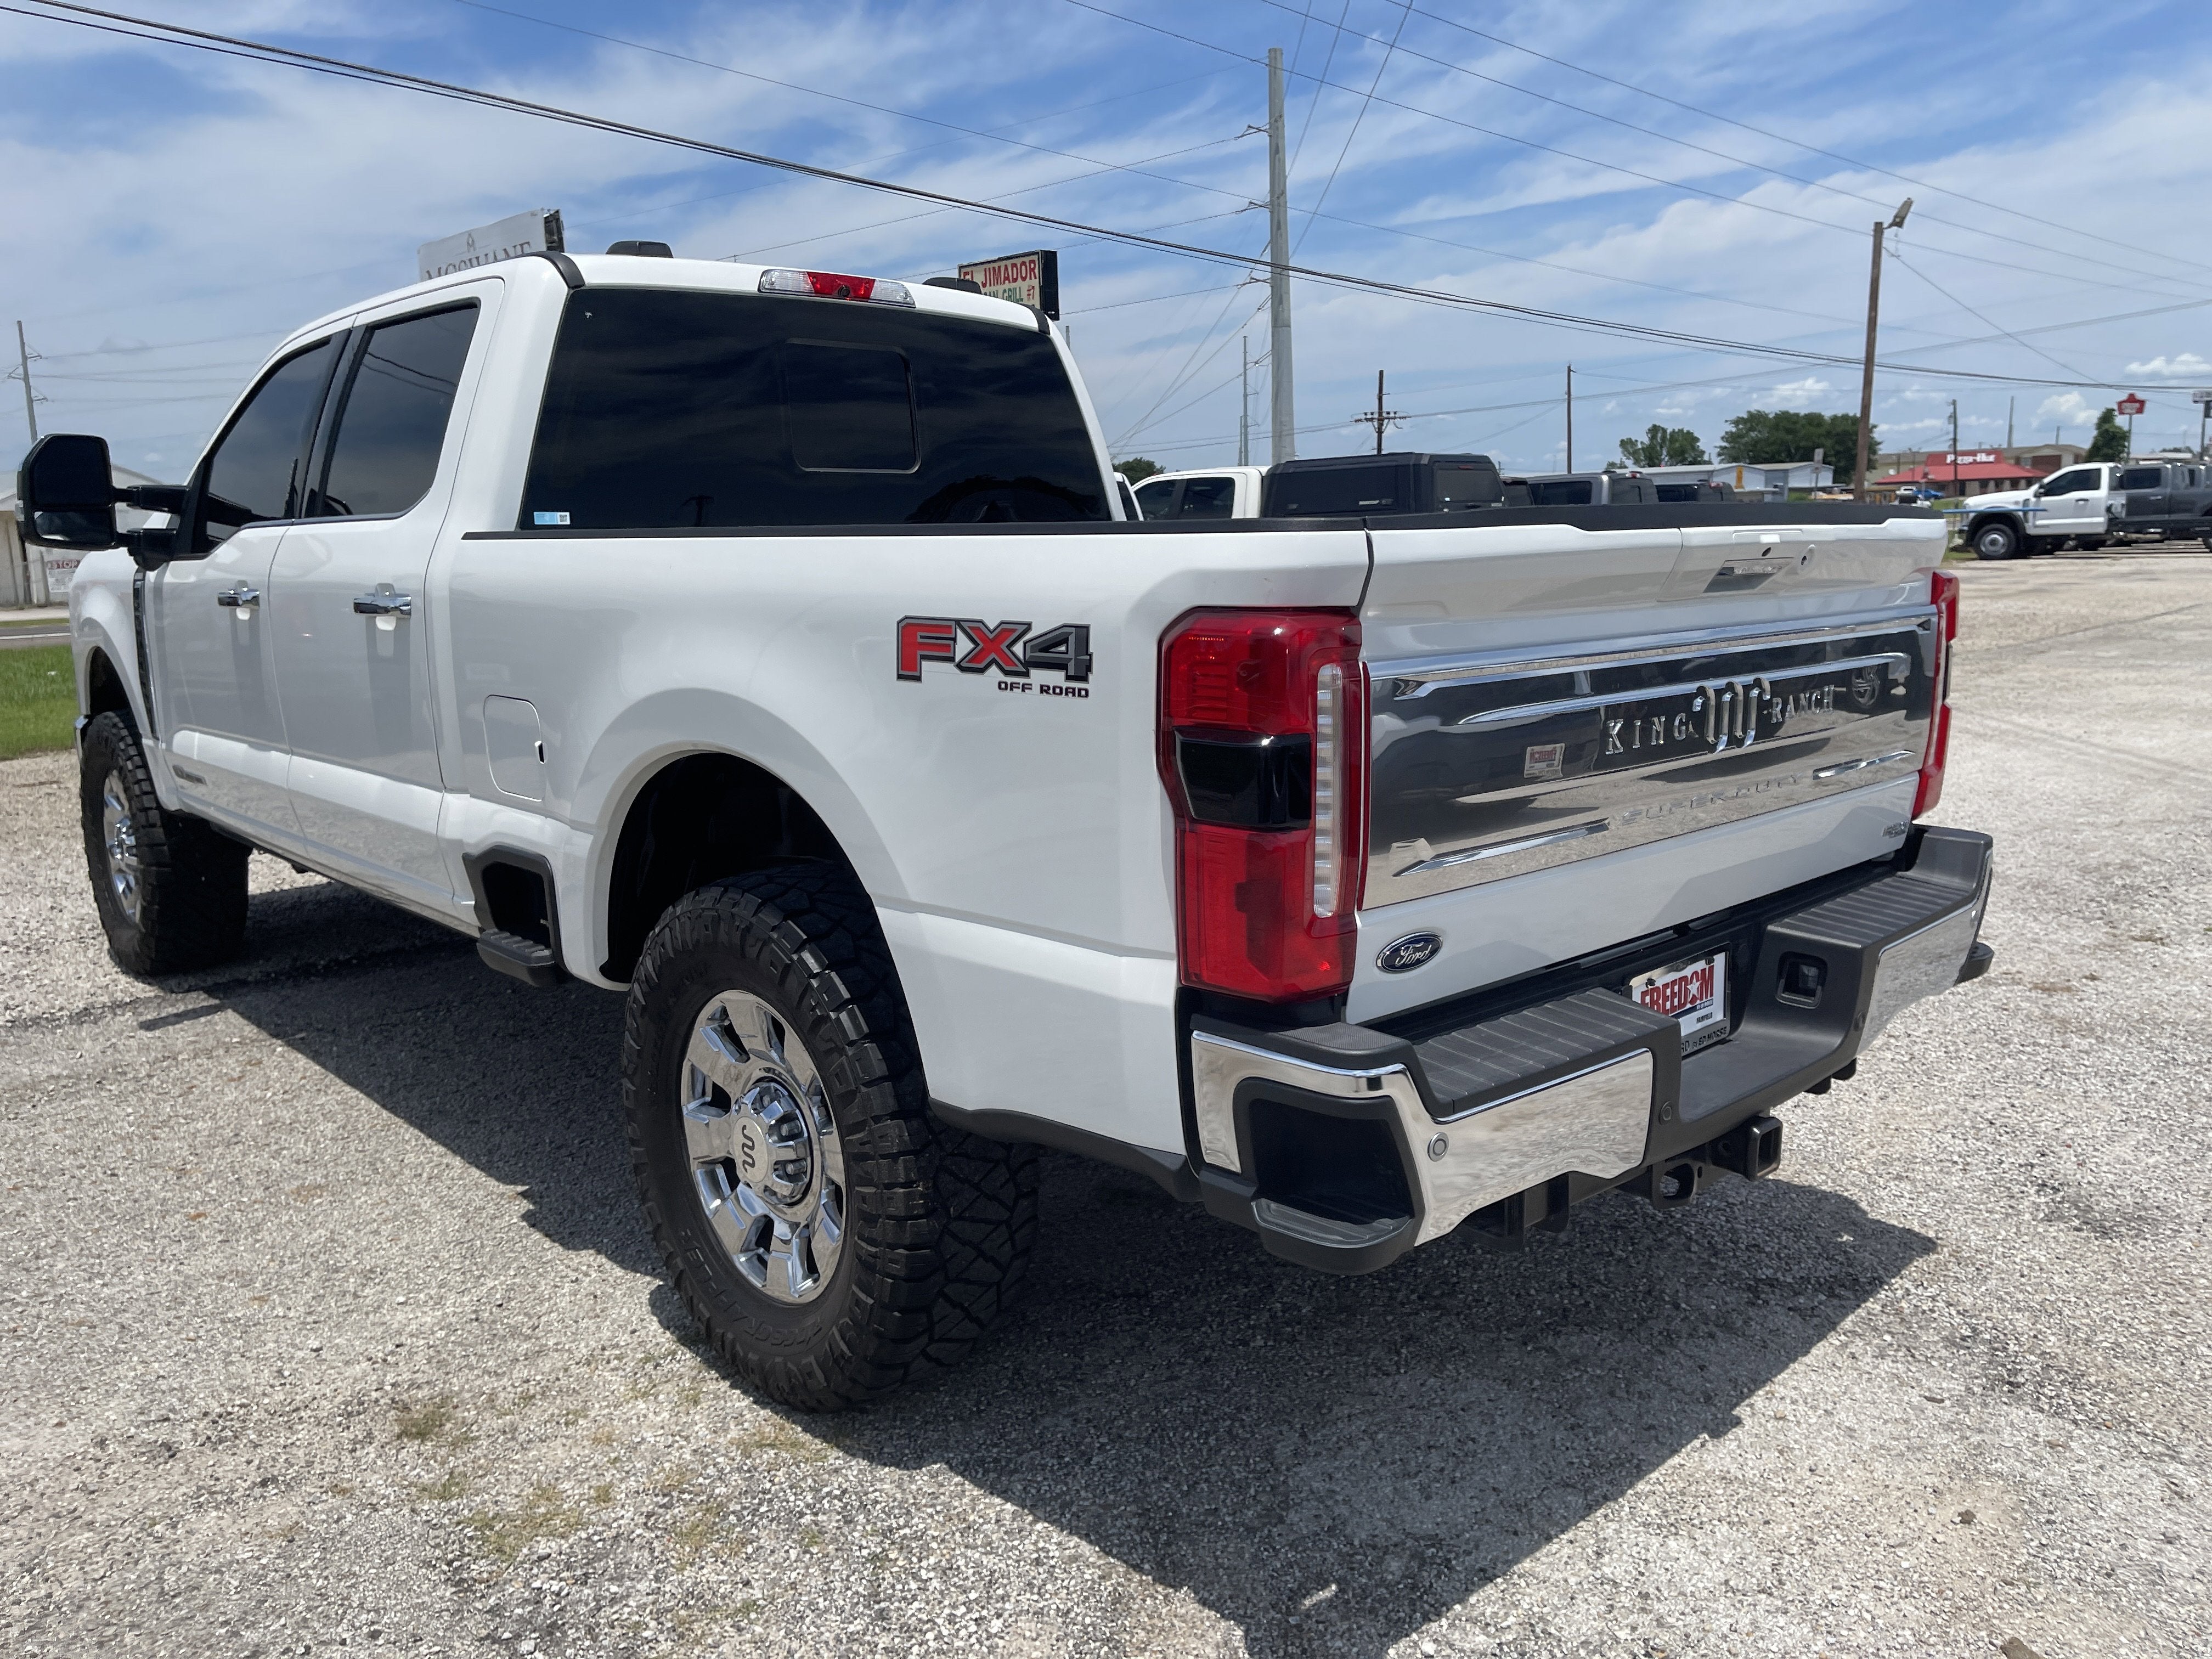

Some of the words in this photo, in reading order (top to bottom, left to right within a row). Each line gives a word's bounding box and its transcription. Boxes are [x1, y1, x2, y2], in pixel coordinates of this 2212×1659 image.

[981, 259, 1037, 288] JIMADOR
[1002, 286, 1024, 302] GRILL
[896, 615, 1093, 683] FX4
[997, 680, 1033, 693] OFF
[1039, 684, 1090, 699] ROAD
[1605, 713, 1686, 755] KING
[1771, 684, 1835, 724] RANCH
[1395, 941, 1432, 967] Ford
[1641, 964, 1714, 1016] FREEDOM
